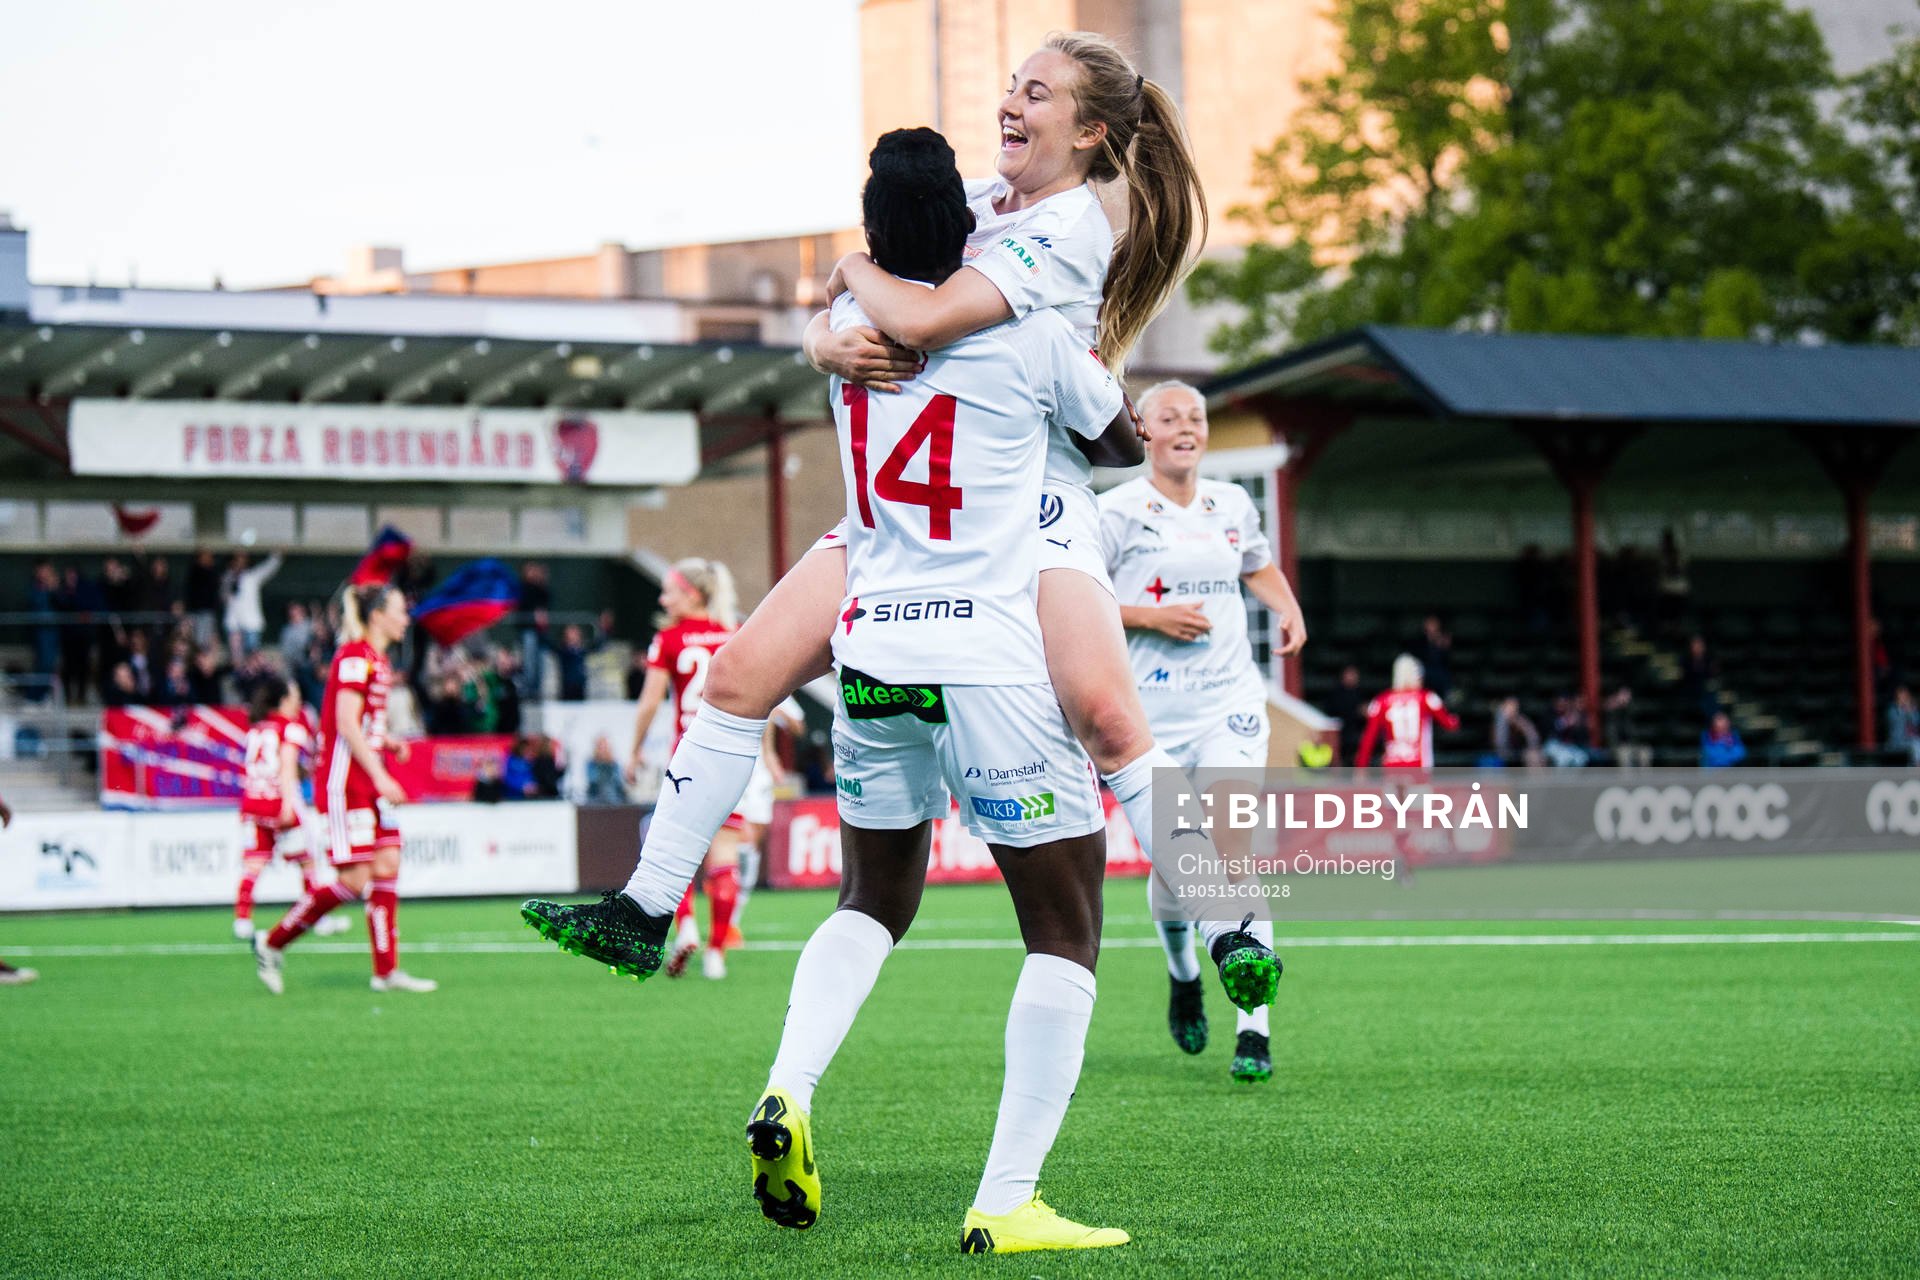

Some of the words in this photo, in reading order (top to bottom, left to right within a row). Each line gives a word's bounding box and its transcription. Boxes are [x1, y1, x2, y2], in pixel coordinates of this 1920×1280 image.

[182, 424, 301, 464] FORZA
[322, 418, 536, 469] ROSENGÅRD
[841, 376, 963, 540] 14
[988, 760, 1046, 781] Damstahl
[978, 800, 1016, 818] MKB
